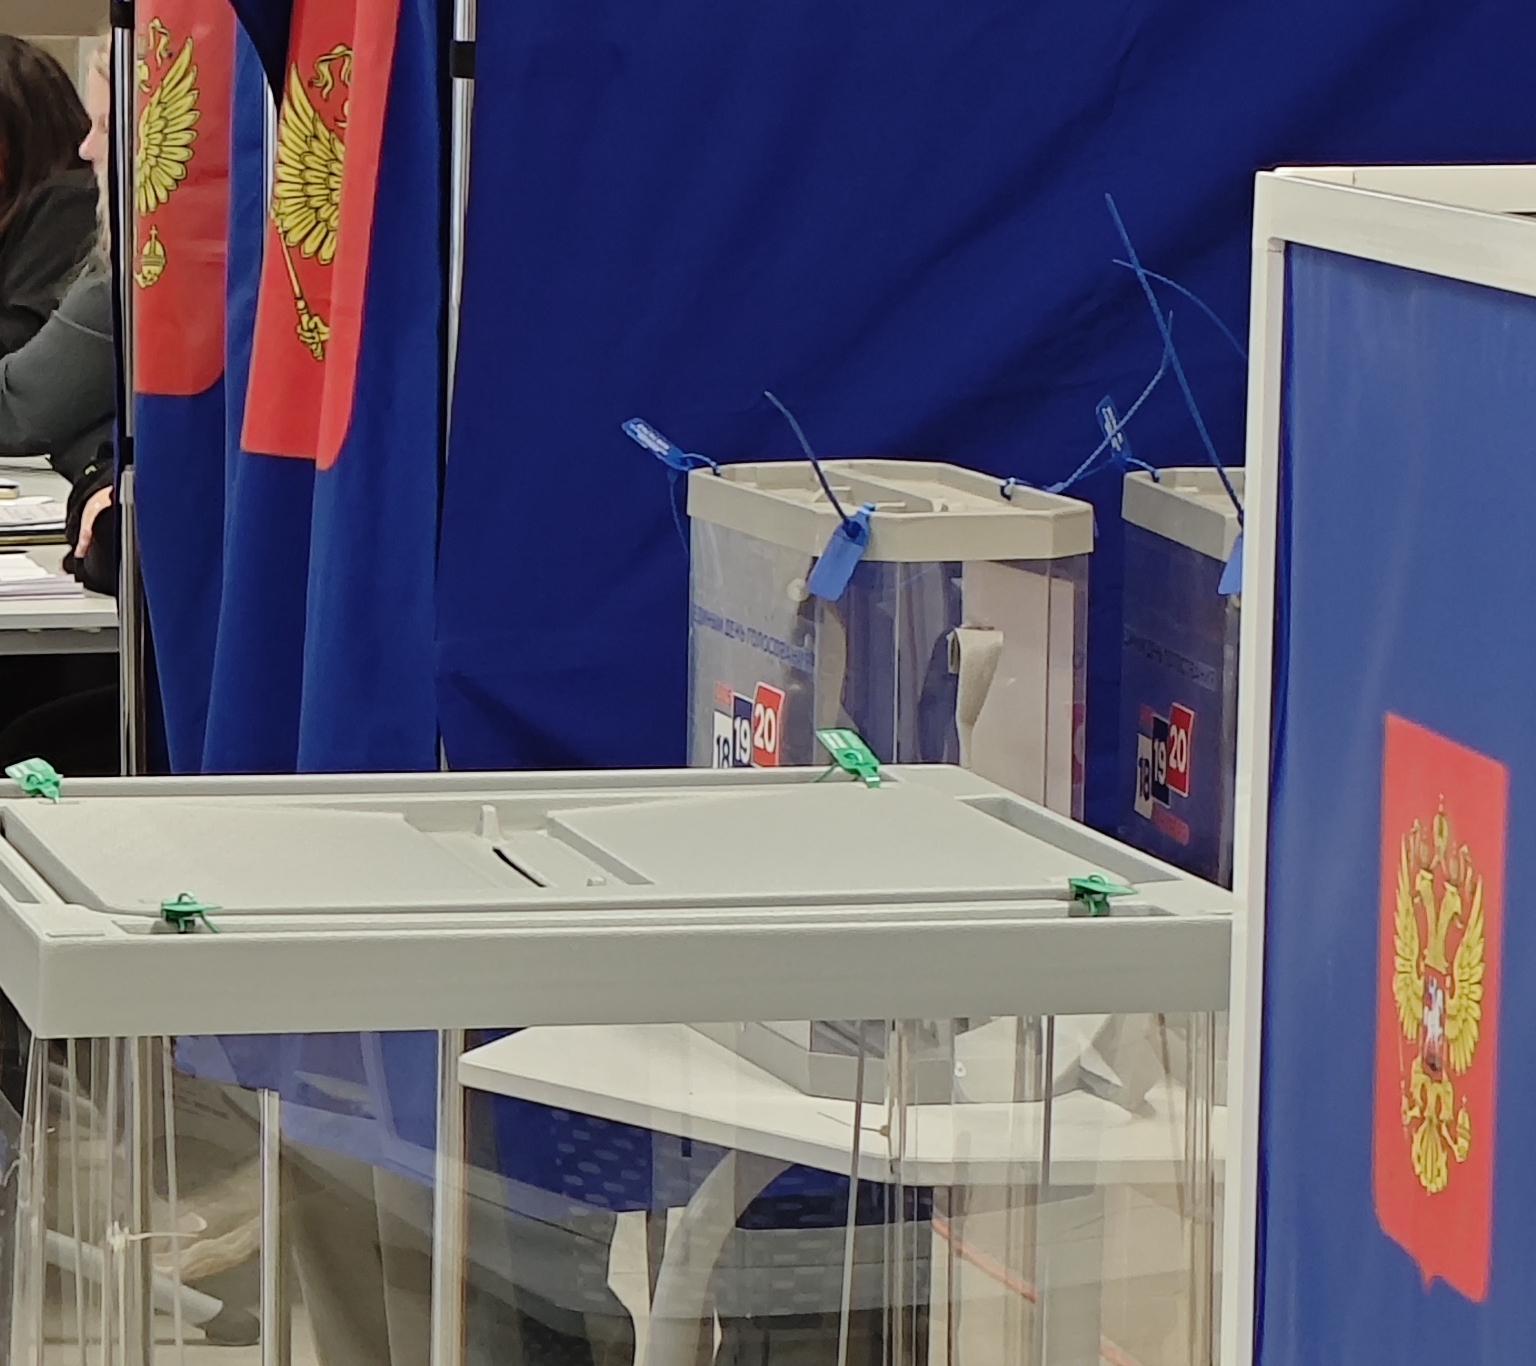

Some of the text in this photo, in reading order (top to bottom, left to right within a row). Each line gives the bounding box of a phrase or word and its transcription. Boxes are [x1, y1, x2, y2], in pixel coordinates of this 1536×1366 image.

[716, 702, 776, 768] 18 19 20
[1138, 724, 1187, 802] 18 19 20
